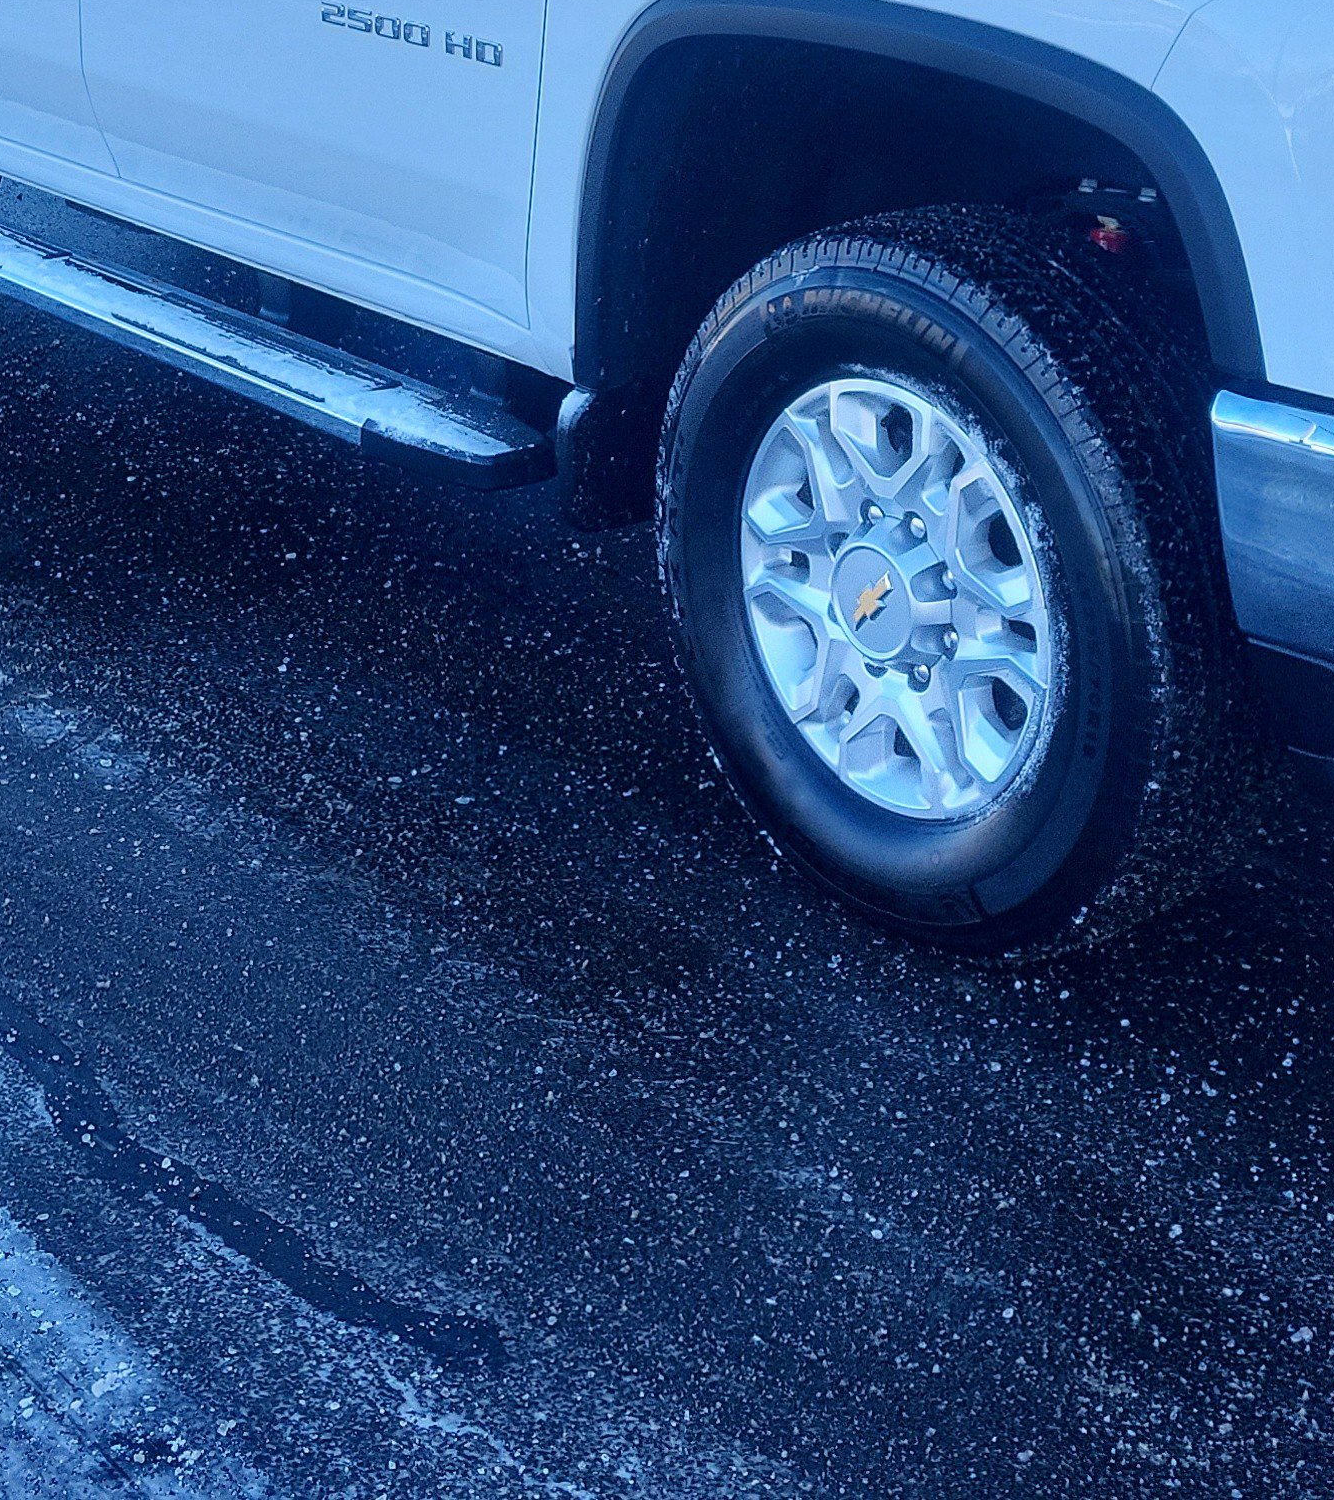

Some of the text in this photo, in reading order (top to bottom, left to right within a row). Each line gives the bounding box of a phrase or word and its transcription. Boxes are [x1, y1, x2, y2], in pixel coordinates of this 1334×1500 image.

[320, 0, 504, 68] 2500 HD
[801, 287, 958, 358] MICHELIN
